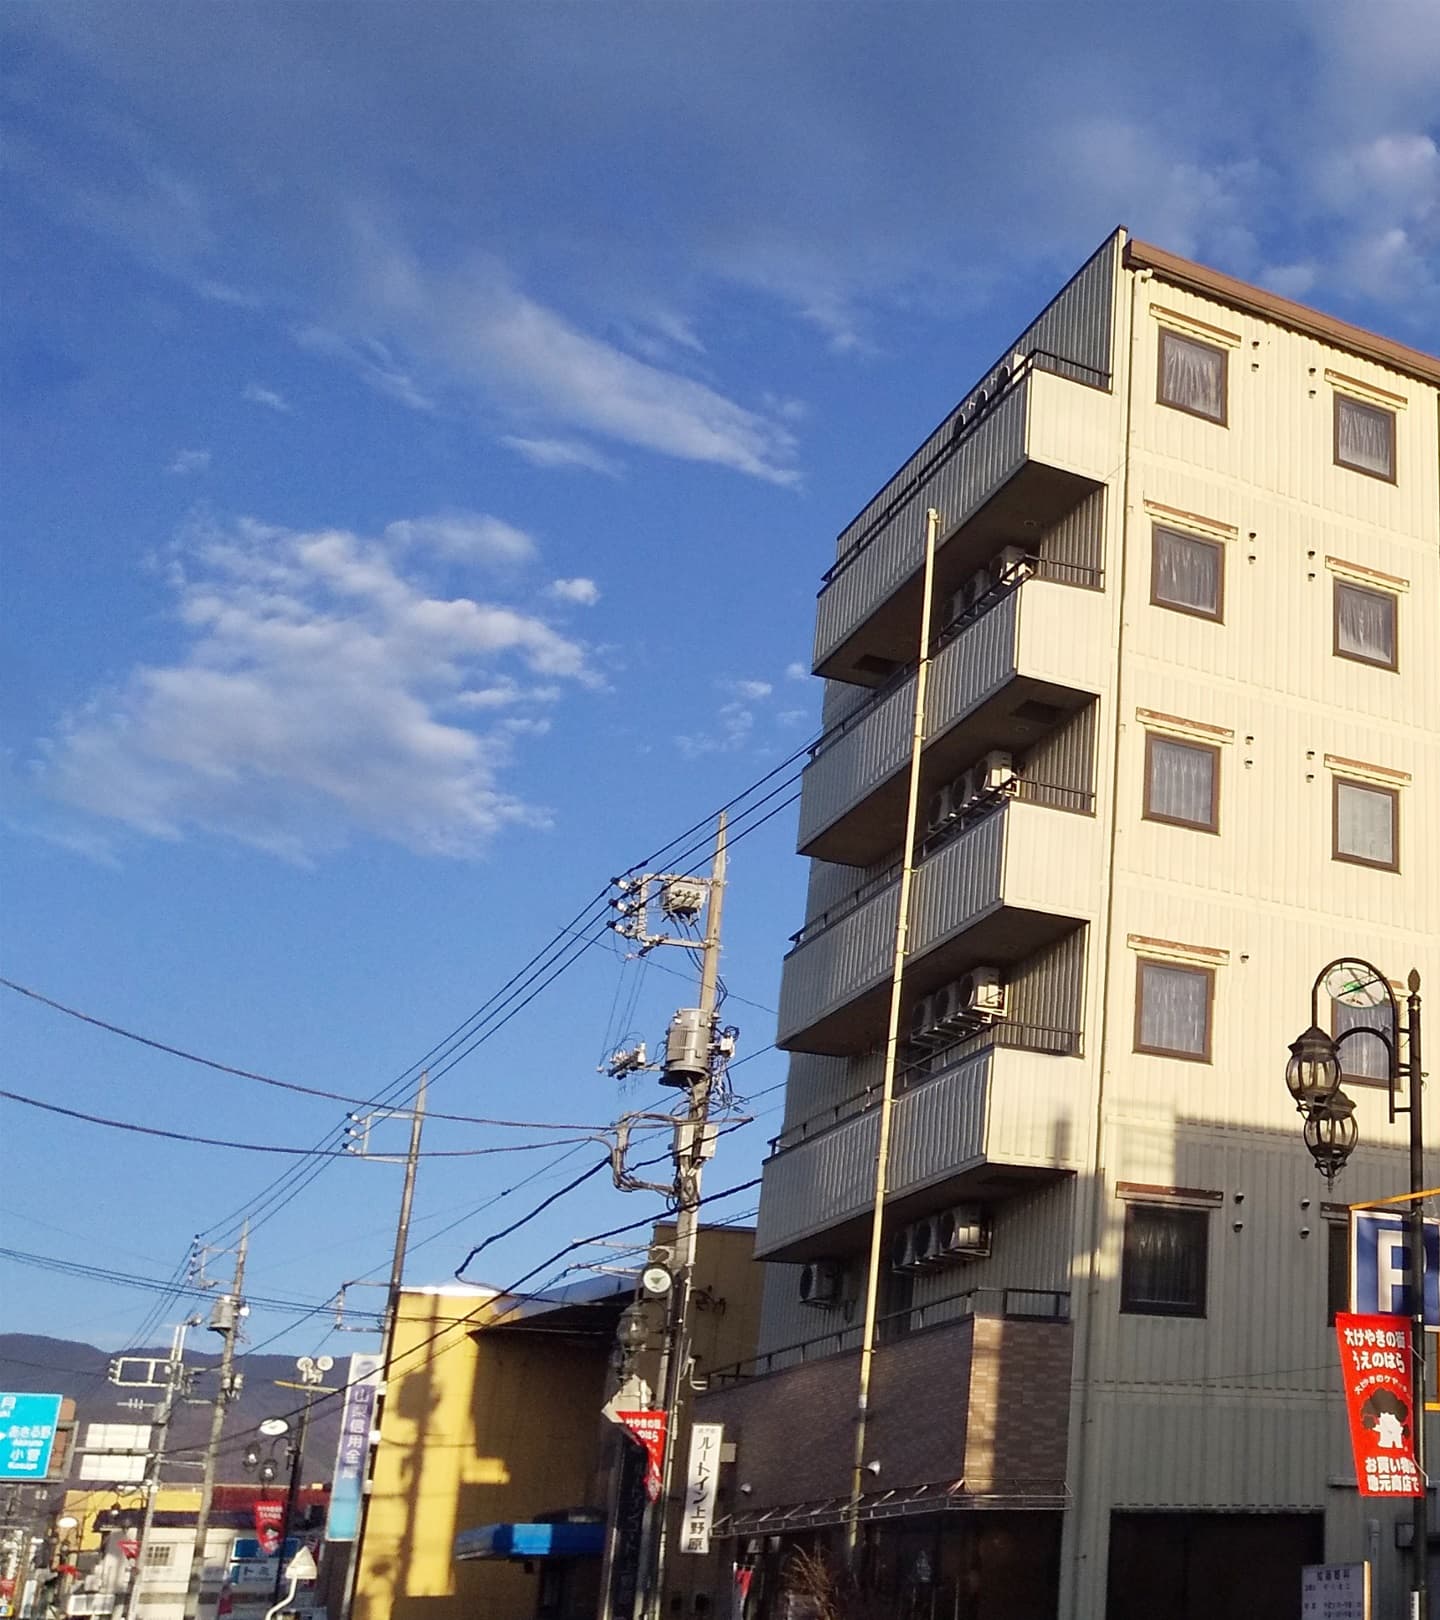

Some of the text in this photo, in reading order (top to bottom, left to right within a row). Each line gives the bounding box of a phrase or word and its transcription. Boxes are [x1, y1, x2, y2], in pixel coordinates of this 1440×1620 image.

[687, 1436, 714, 1551] ルートイン上野原
